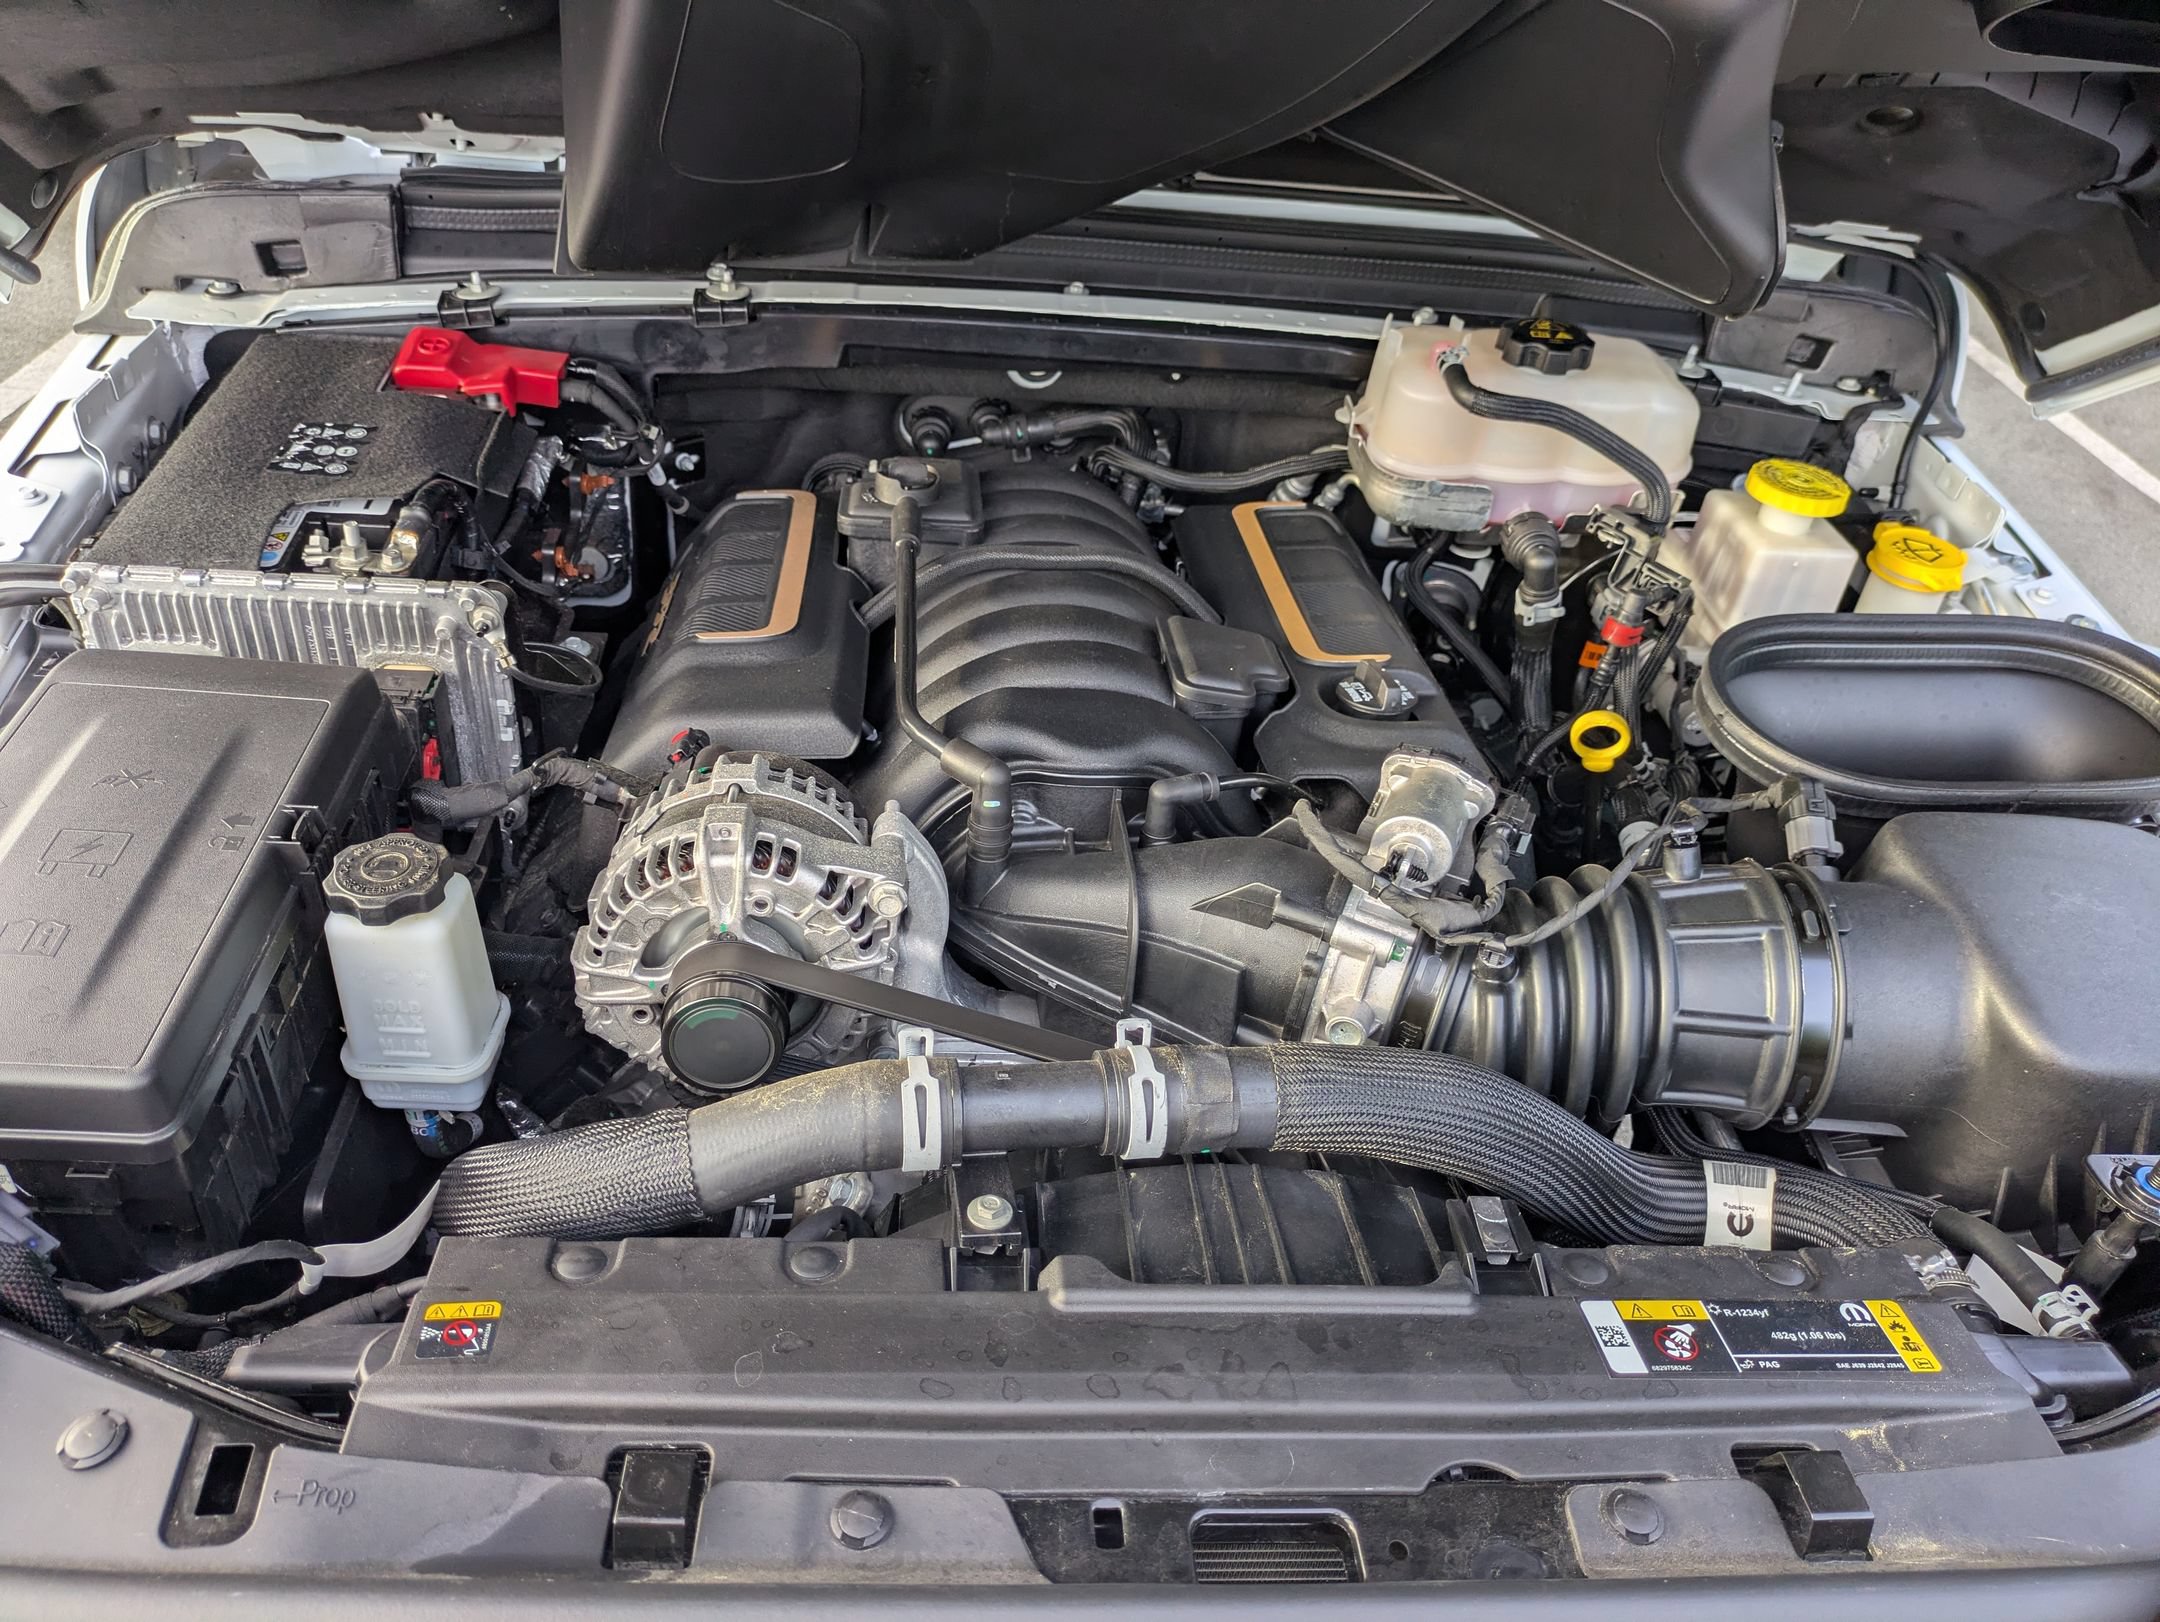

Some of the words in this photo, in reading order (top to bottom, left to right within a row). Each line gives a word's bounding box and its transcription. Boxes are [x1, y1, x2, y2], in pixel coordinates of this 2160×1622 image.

[374, 1014, 425, 1028] MAX
[378, 1038, 428, 1051] MIN
[1723, 1309, 1769, 1318] R-1234yf
[1771, 1331, 1797, 1341] 482g
[1797, 1331, 1823, 1341] (1.06
[1824, 1331, 1846, 1341] lbs)
[1759, 1361, 1780, 1369] PAG
[297, 1480, 356, 1514] Prop
